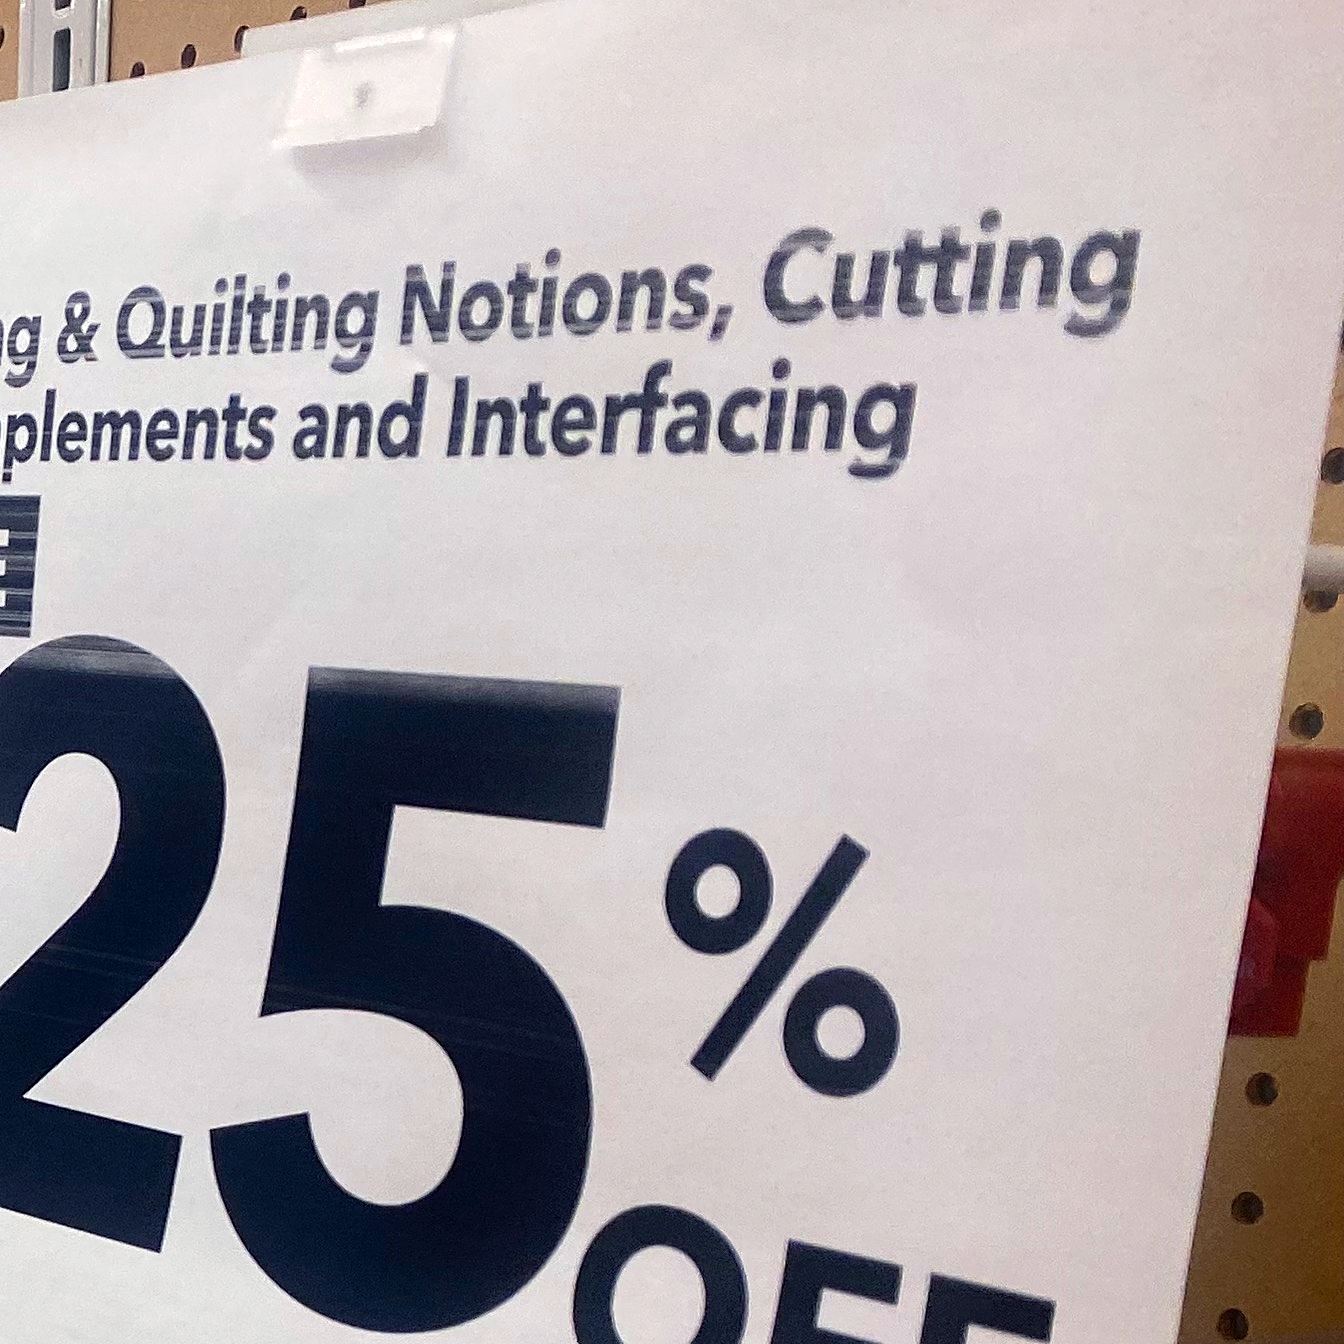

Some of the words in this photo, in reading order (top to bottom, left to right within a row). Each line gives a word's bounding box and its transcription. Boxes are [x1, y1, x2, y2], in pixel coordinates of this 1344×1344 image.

[57, 291, 99, 363] &
[116, 273, 379, 375] Quilting
[400, 249, 733, 345] Notions,
[763, 209, 1141, 340] Cutting
[292, 376, 428, 461] and
[447, 364, 917, 480] Interfacing
